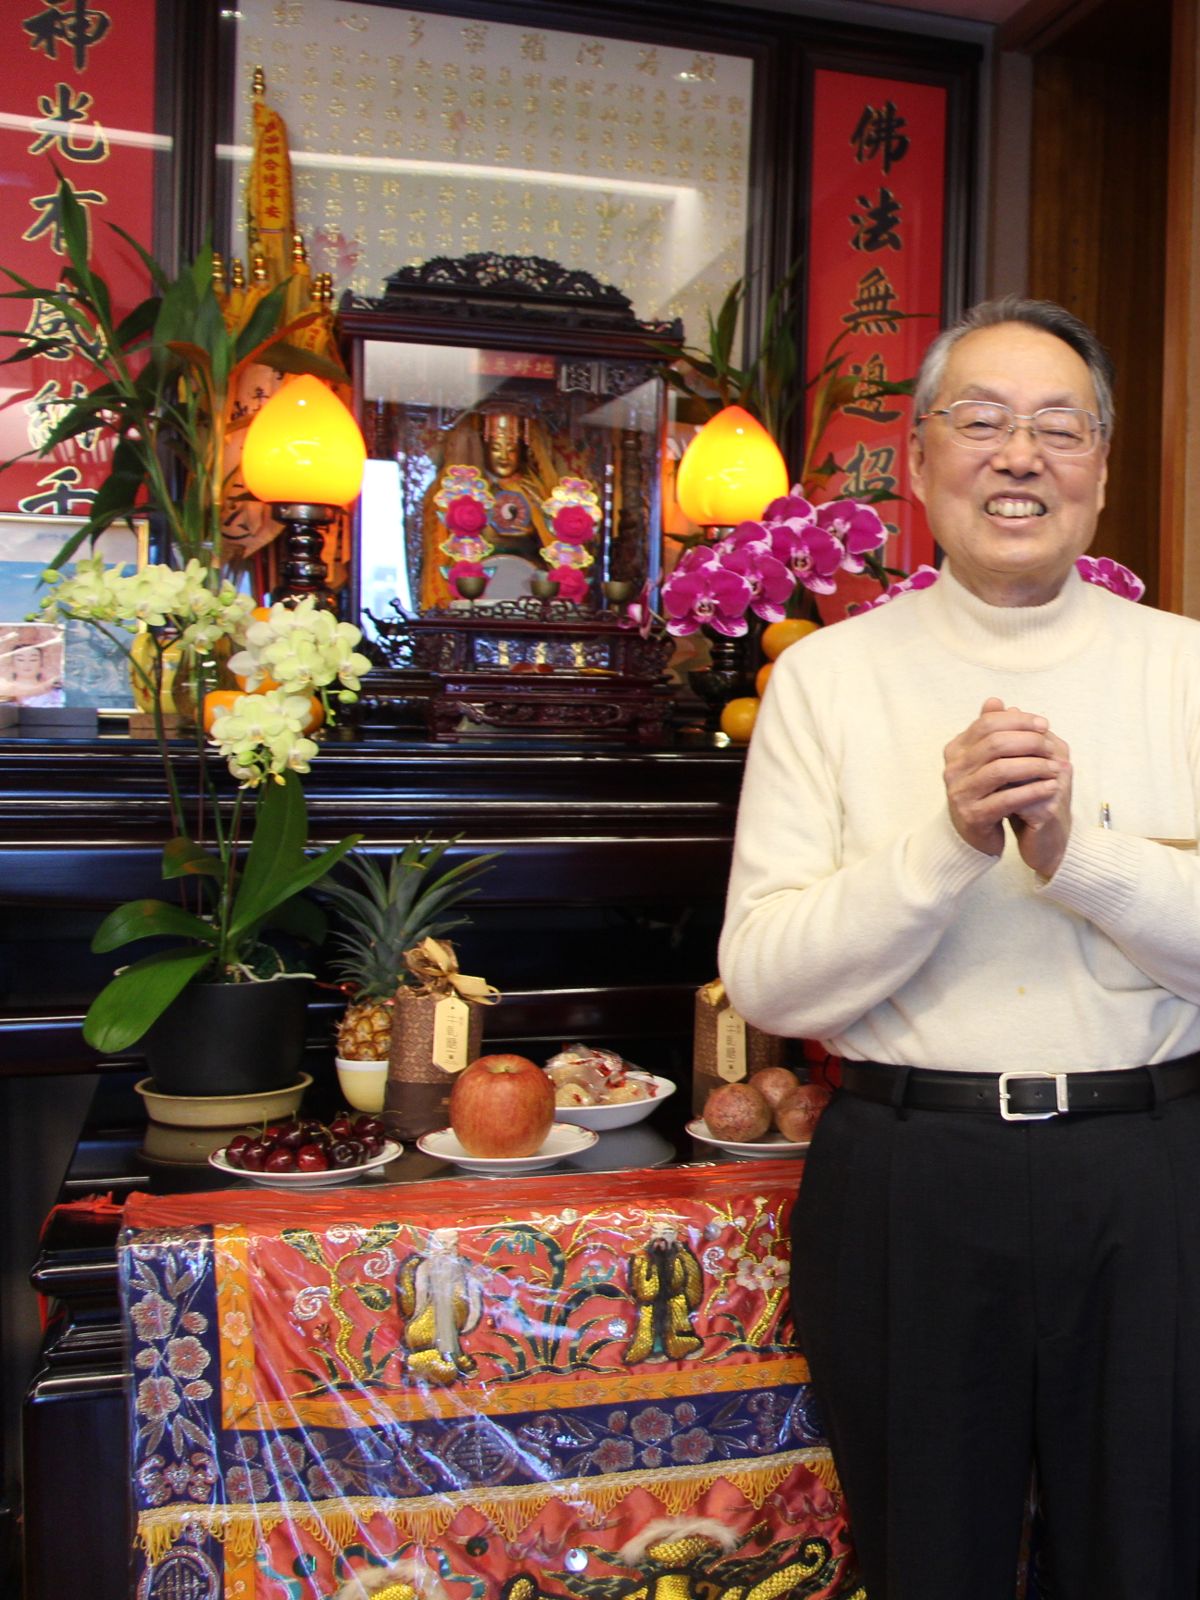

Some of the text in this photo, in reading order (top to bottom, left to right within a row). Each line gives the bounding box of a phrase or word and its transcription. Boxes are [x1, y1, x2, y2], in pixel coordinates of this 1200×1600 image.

[839, 97, 912, 580] 佛法無邊招
